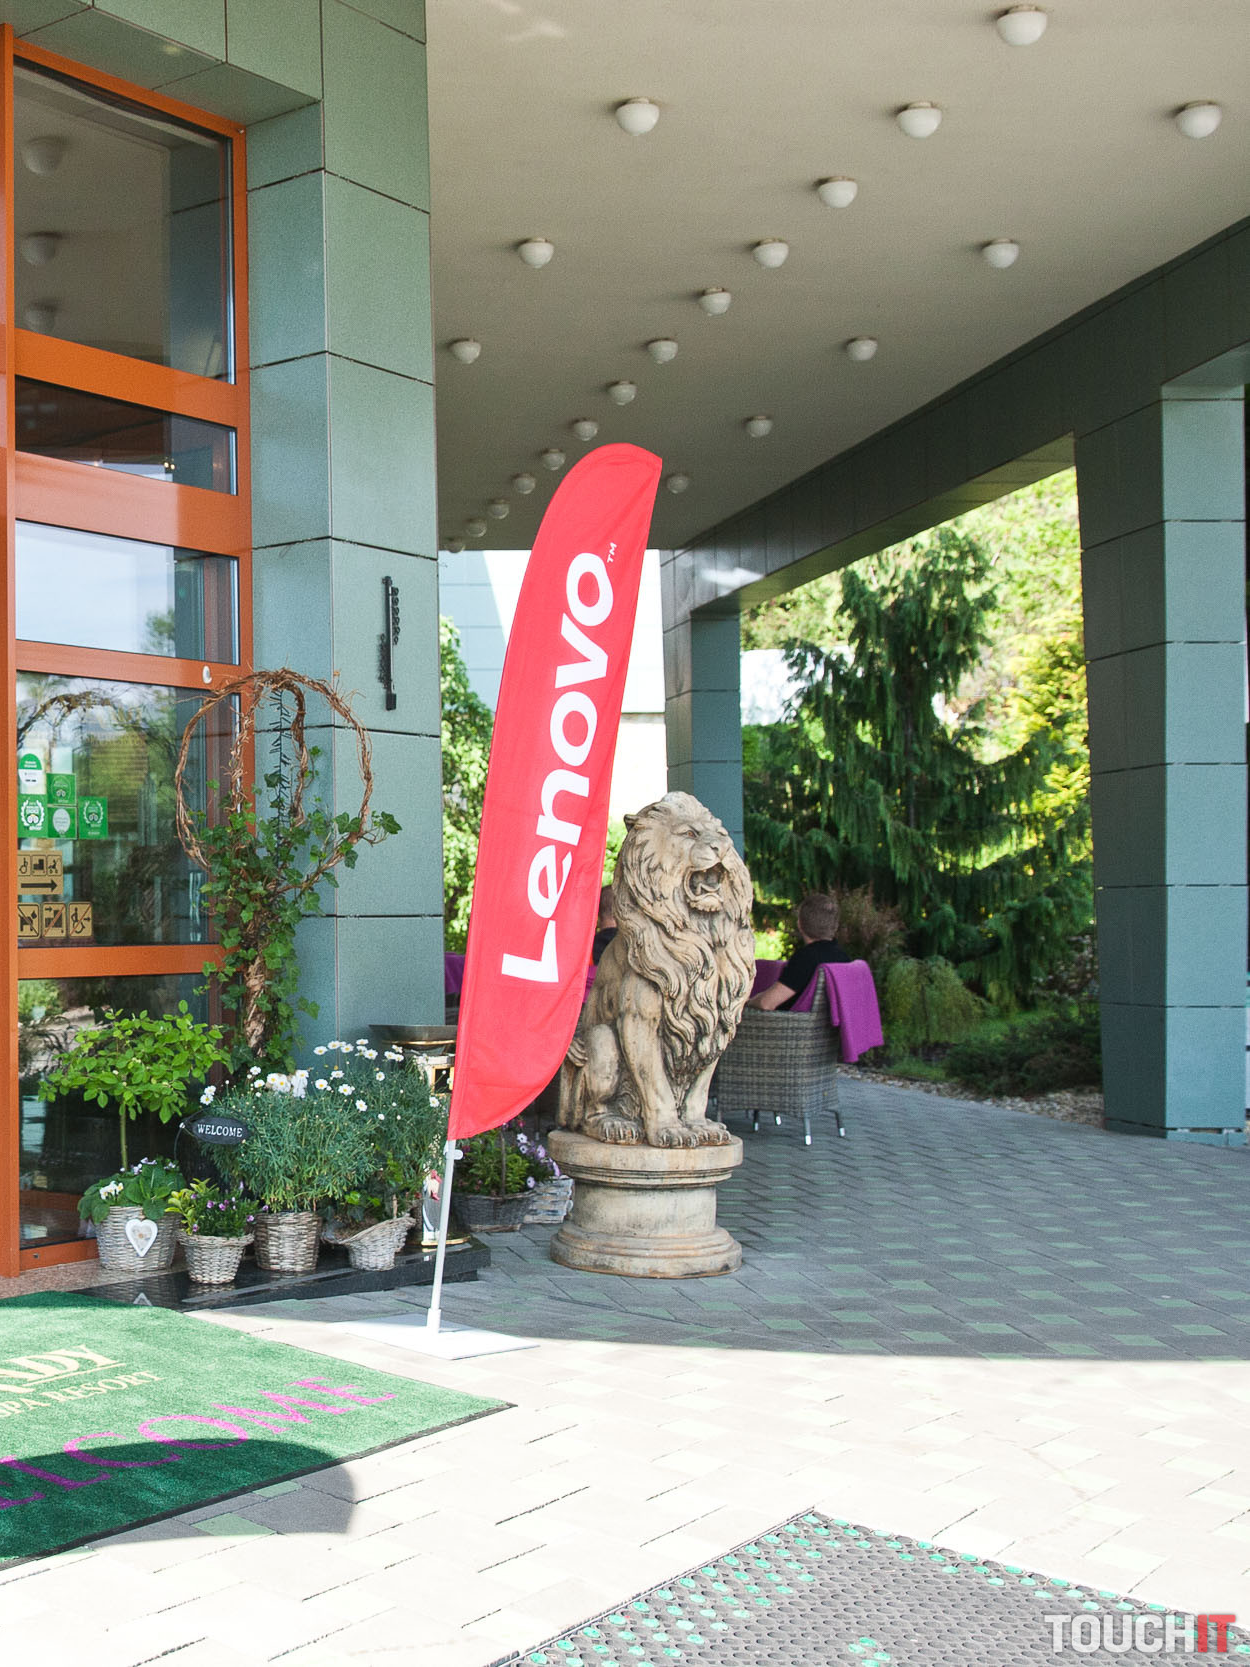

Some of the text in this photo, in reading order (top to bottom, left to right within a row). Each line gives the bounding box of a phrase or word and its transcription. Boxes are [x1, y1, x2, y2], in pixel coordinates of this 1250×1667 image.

[501, 552, 613, 983] Lenovo
[197, 1124, 243, 1137] WELCOME
[43, 1369, 165, 1402] RESORT
